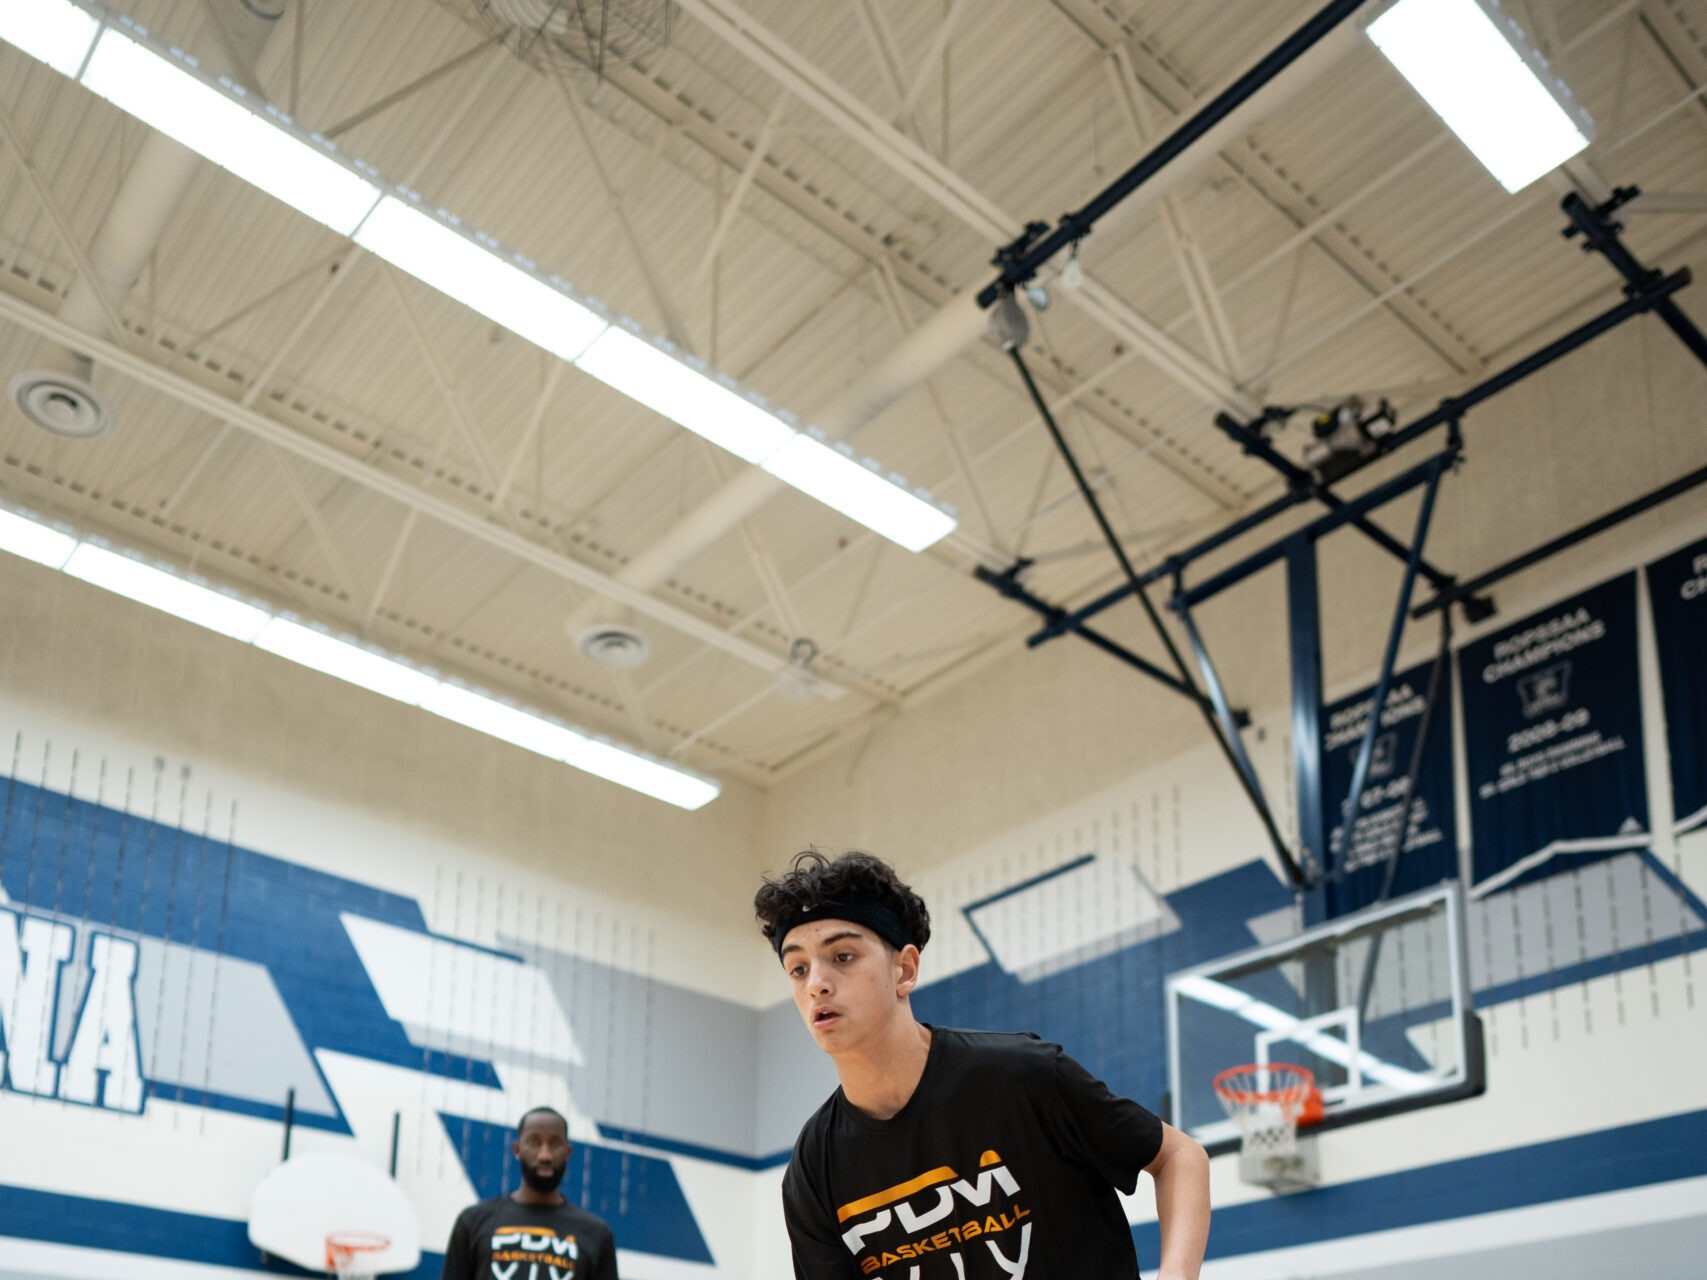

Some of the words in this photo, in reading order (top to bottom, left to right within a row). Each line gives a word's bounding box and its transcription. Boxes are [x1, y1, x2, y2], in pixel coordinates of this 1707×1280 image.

[1482, 619, 1607, 684] CHAMPIONS
[491, 1250, 575, 1271] BASKETBALL
[860, 1203, 1032, 1275] BASKETBALL
